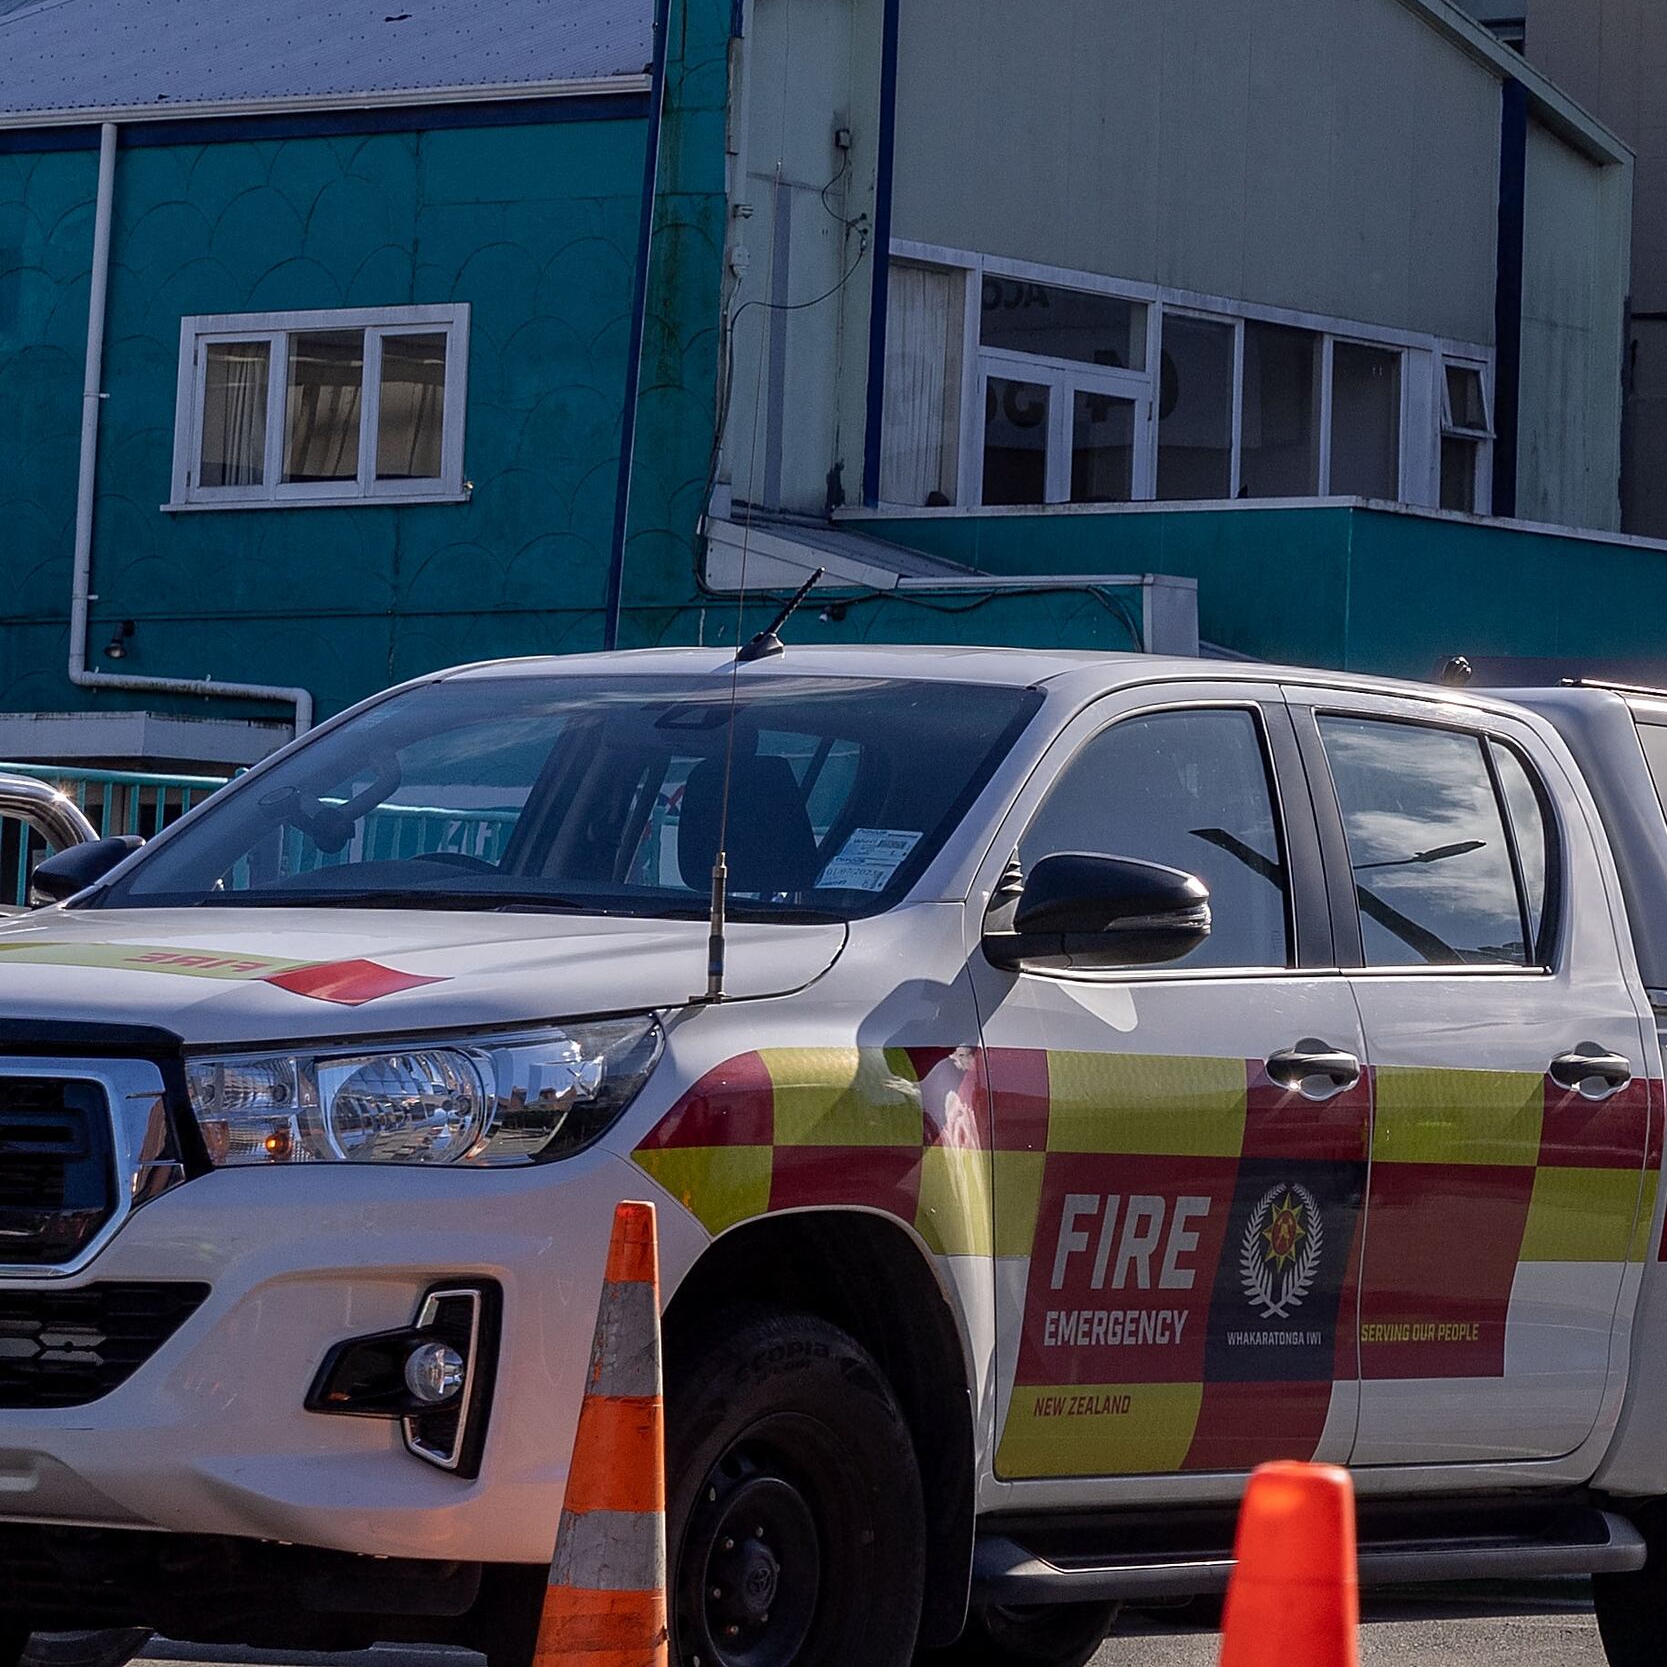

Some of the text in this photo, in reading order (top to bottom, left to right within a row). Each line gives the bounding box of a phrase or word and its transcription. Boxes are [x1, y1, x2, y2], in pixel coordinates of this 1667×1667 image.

[1050, 1194, 1212, 1290] FIRE
[1044, 1309, 1189, 1346] EMERGENCY
[1226, 1331, 1322, 1346] WHAKARATONGA IWI
[1360, 1323, 1479, 1342] SERVING OUR PEOPLE
[1034, 1395, 1131, 1417] NEW ZEALAND
